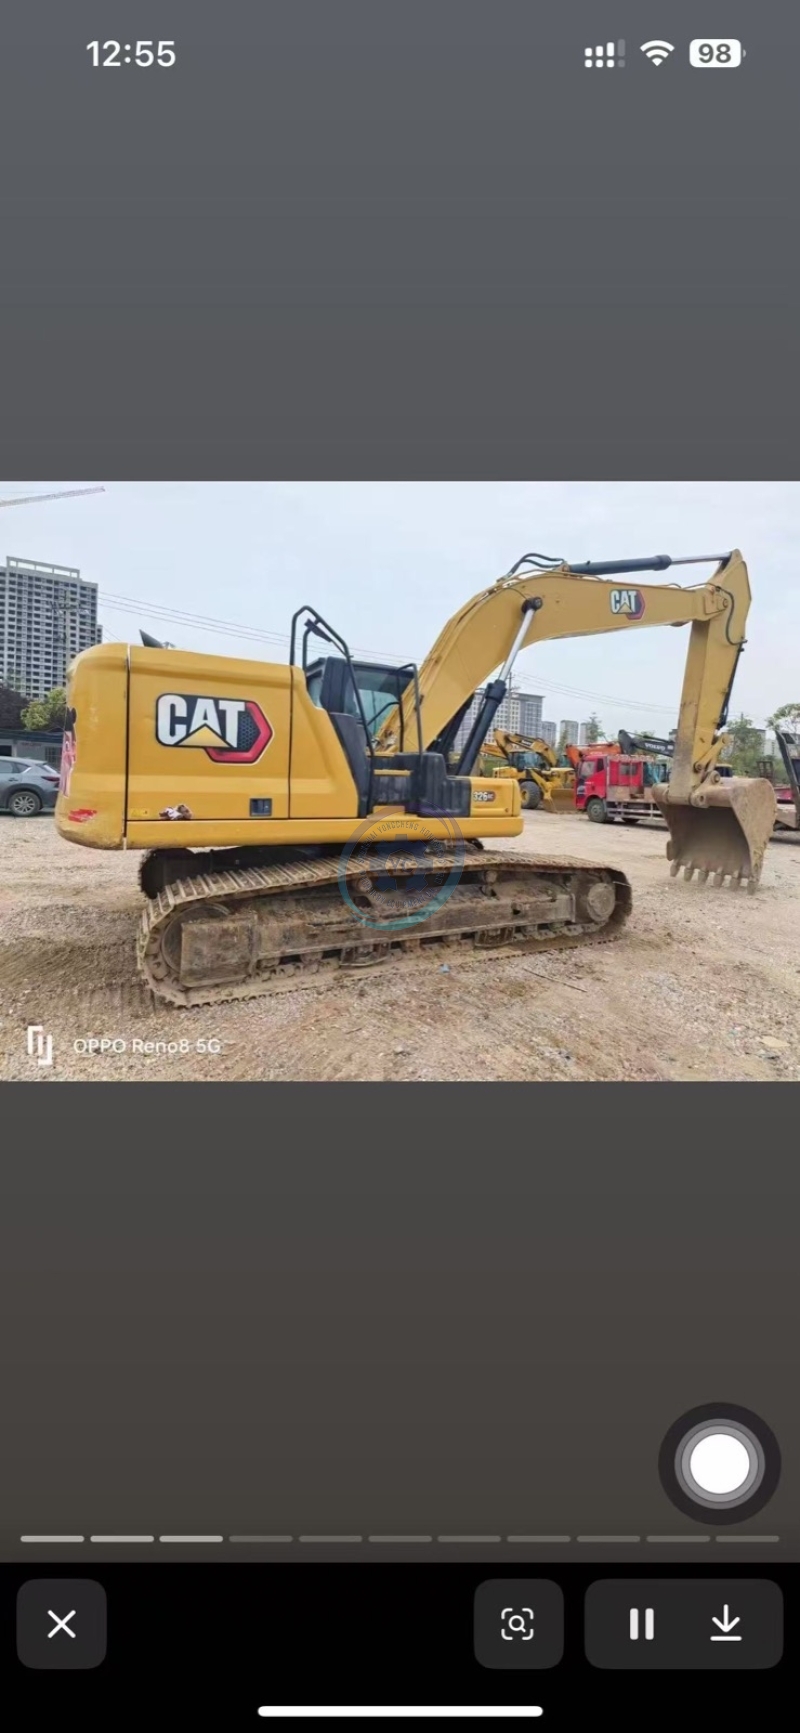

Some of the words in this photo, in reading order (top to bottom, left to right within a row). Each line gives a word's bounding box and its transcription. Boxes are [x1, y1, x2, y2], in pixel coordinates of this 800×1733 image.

[610, 589, 638, 614] CAT
[157, 693, 246, 749] CAT
[644, 742, 666, 752] VOLVO
[473, 791, 488, 802] 326
